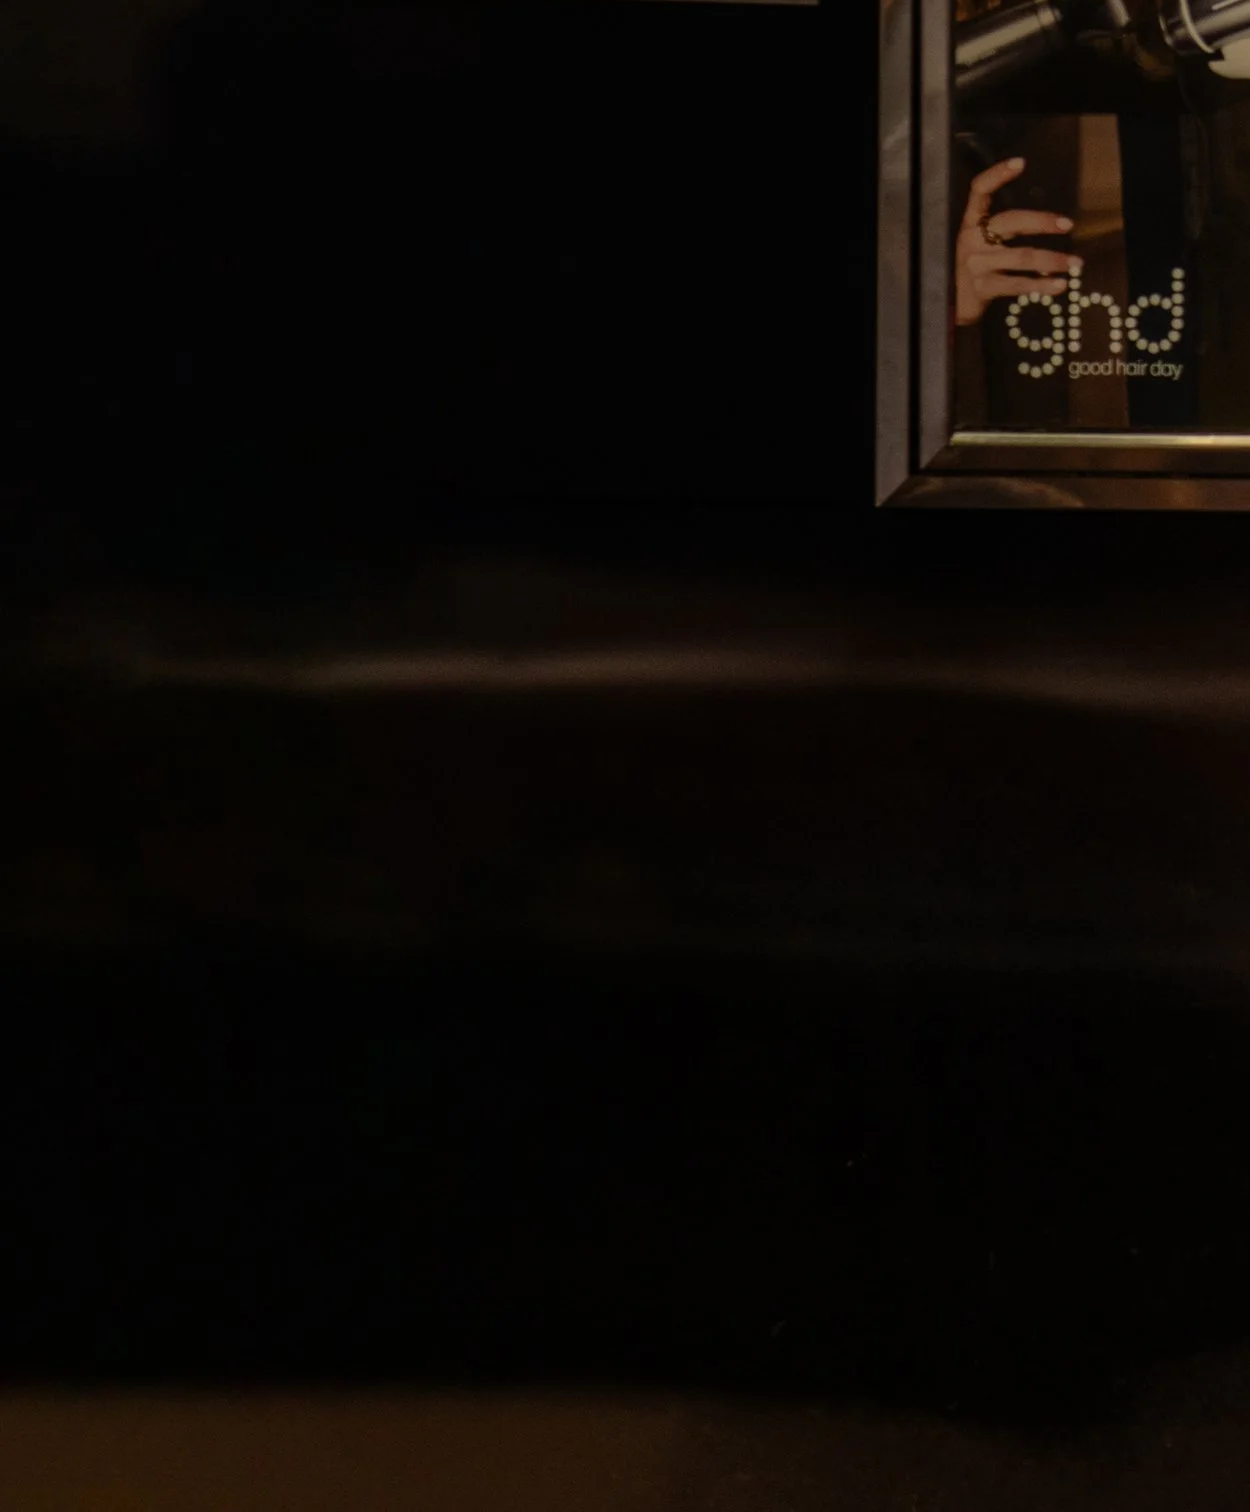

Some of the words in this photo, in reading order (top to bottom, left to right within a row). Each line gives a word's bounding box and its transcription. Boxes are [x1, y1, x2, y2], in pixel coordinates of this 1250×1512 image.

[1006, 264, 1185, 378] ghd
[1068, 360, 1113, 380] good
[1115, 359, 1148, 377] hair
[1150, 360, 1184, 381] day
